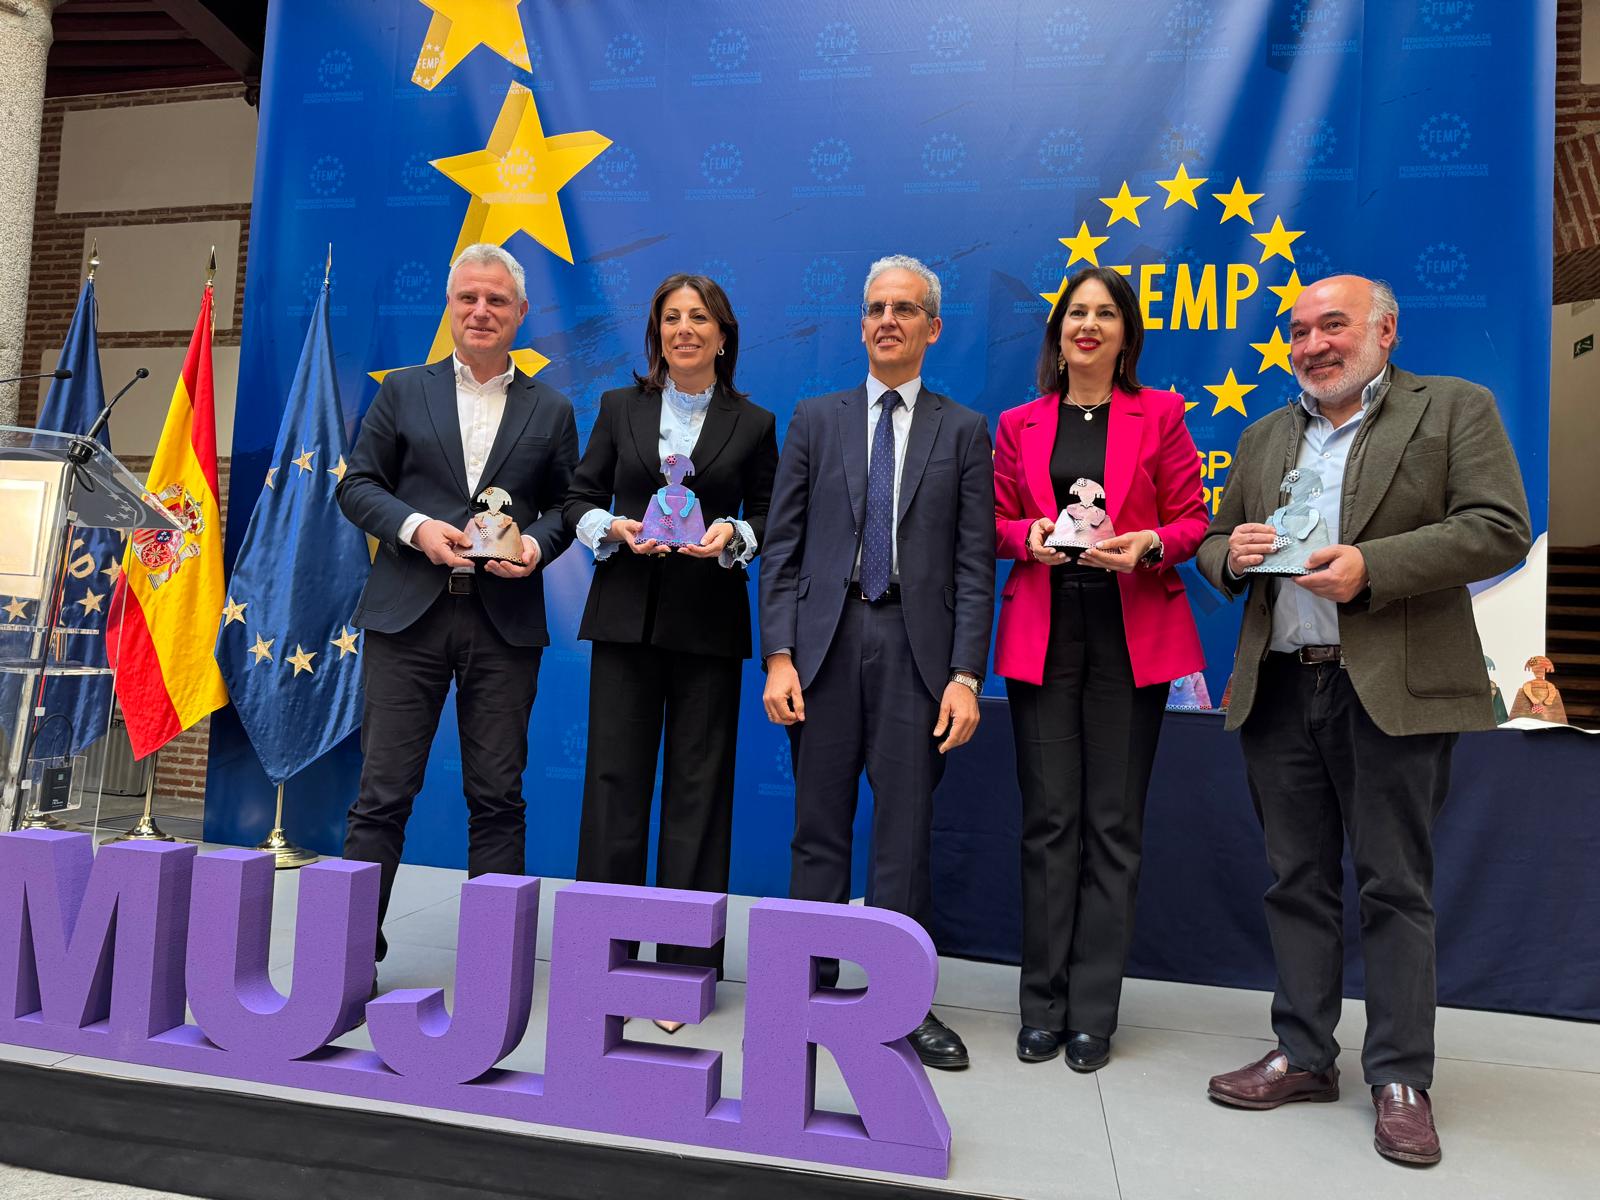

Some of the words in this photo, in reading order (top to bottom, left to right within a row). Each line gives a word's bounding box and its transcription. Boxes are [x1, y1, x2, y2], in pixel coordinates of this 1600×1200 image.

[1432, 0, 1464, 16] FEMP
[1174, 15, 1203, 29] FEMP
[1300, 8, 1330, 24] FEMP
[935, 29, 963, 43] FEMP
[1053, 22, 1081, 36] FEMP
[716, 42, 741, 55] FEMP
[824, 36, 849, 49] FEMP
[612, 47, 637, 60] FEMP
[324, 62, 346, 74] FEMP
[417, 57, 440, 70] FEMP
[1296, 133, 1327, 148] FEMP
[1429, 129, 1462, 143] FEMP
[1047, 143, 1075, 157] FEMP
[1169, 138, 1200, 153] FEMP
[817, 153, 843, 167] FEMP
[930, 148, 957, 162] FEMP
[605, 160, 630, 173] FEMP
[709, 156, 735, 170] FEMP
[316, 169, 338, 182] FEMP
[409, 166, 432, 178] FEMP
[1299, 262, 1324, 276] EMP
[1426, 260, 1458, 273] FEMP
[401, 275, 424, 288] FEMP
[597, 274, 623, 286] FEMP
[811, 272, 837, 285] FEMP
[0, 829, 951, 1172] MUJER
